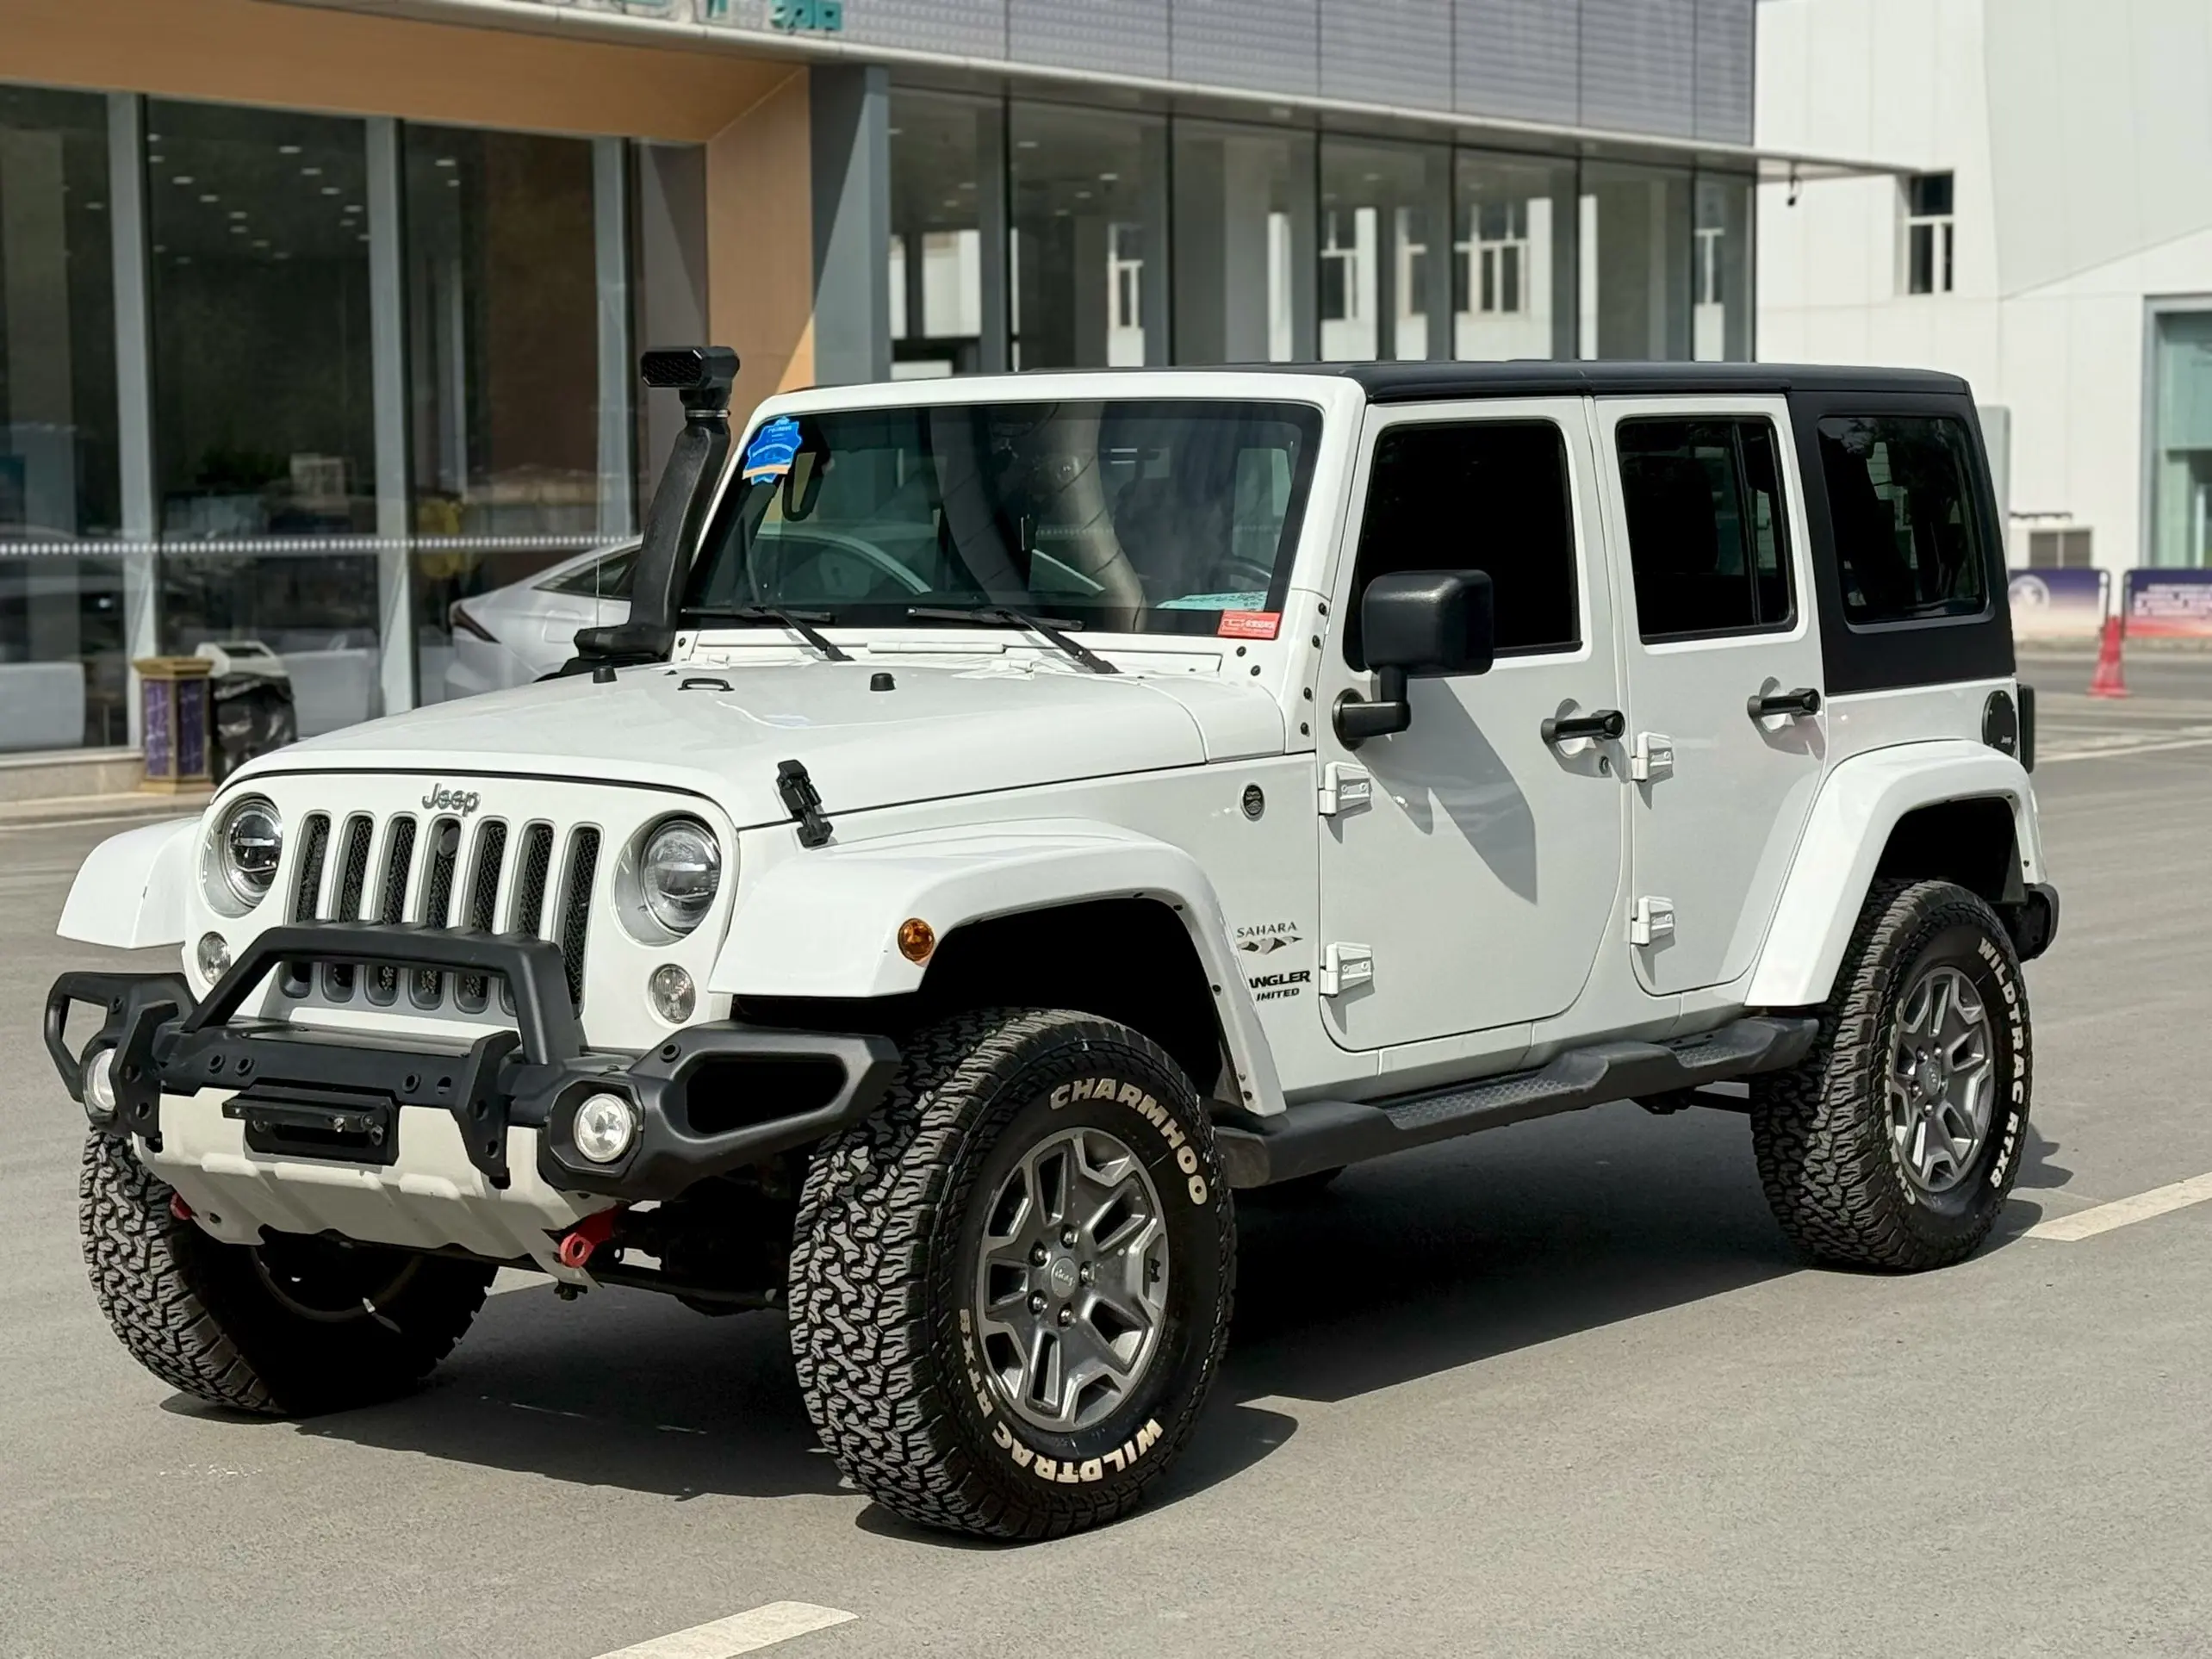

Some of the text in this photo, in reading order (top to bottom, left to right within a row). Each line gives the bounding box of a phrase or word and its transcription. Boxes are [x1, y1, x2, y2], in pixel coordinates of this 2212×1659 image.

[421, 782, 481, 817] Jeep
[1236, 921, 1298, 939] SAHARA
[1249, 970, 1311, 989] NGLER
[1256, 987, 1300, 1002] IMITED
[1978, 937, 2025, 1104] WILDTRAC
[1050, 1078, 1208, 1205] CHARMHOO
[991, 1418, 1164, 1483] WILDTRAC
